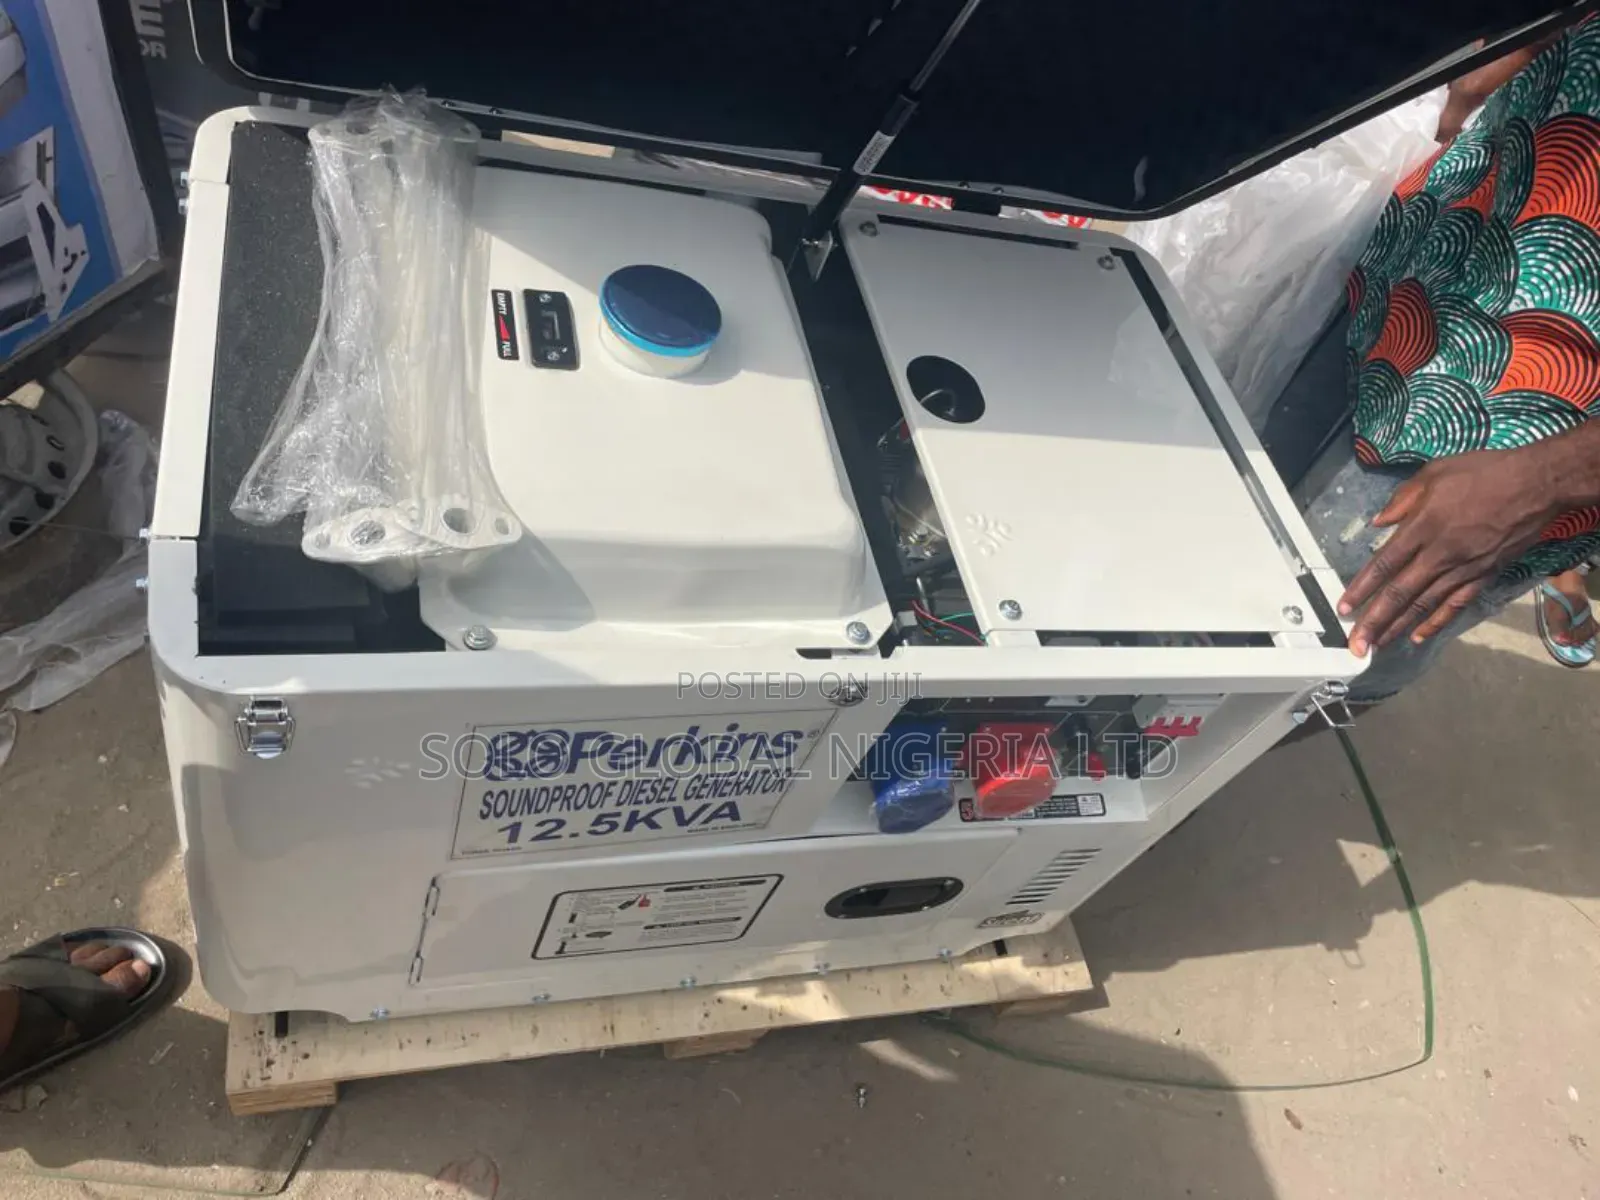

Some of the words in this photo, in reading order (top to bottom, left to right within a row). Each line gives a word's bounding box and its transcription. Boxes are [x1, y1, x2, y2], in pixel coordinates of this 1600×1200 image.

[496, 292, 507, 315] EMPTY
[501, 341, 512, 357] FULL
[479, 780, 620, 820] SOUNDPROOF
[615, 776, 678, 807] DIESEL
[684, 767, 793, 801] GENERATOR
[498, 801, 741, 844] 12.5KVA
